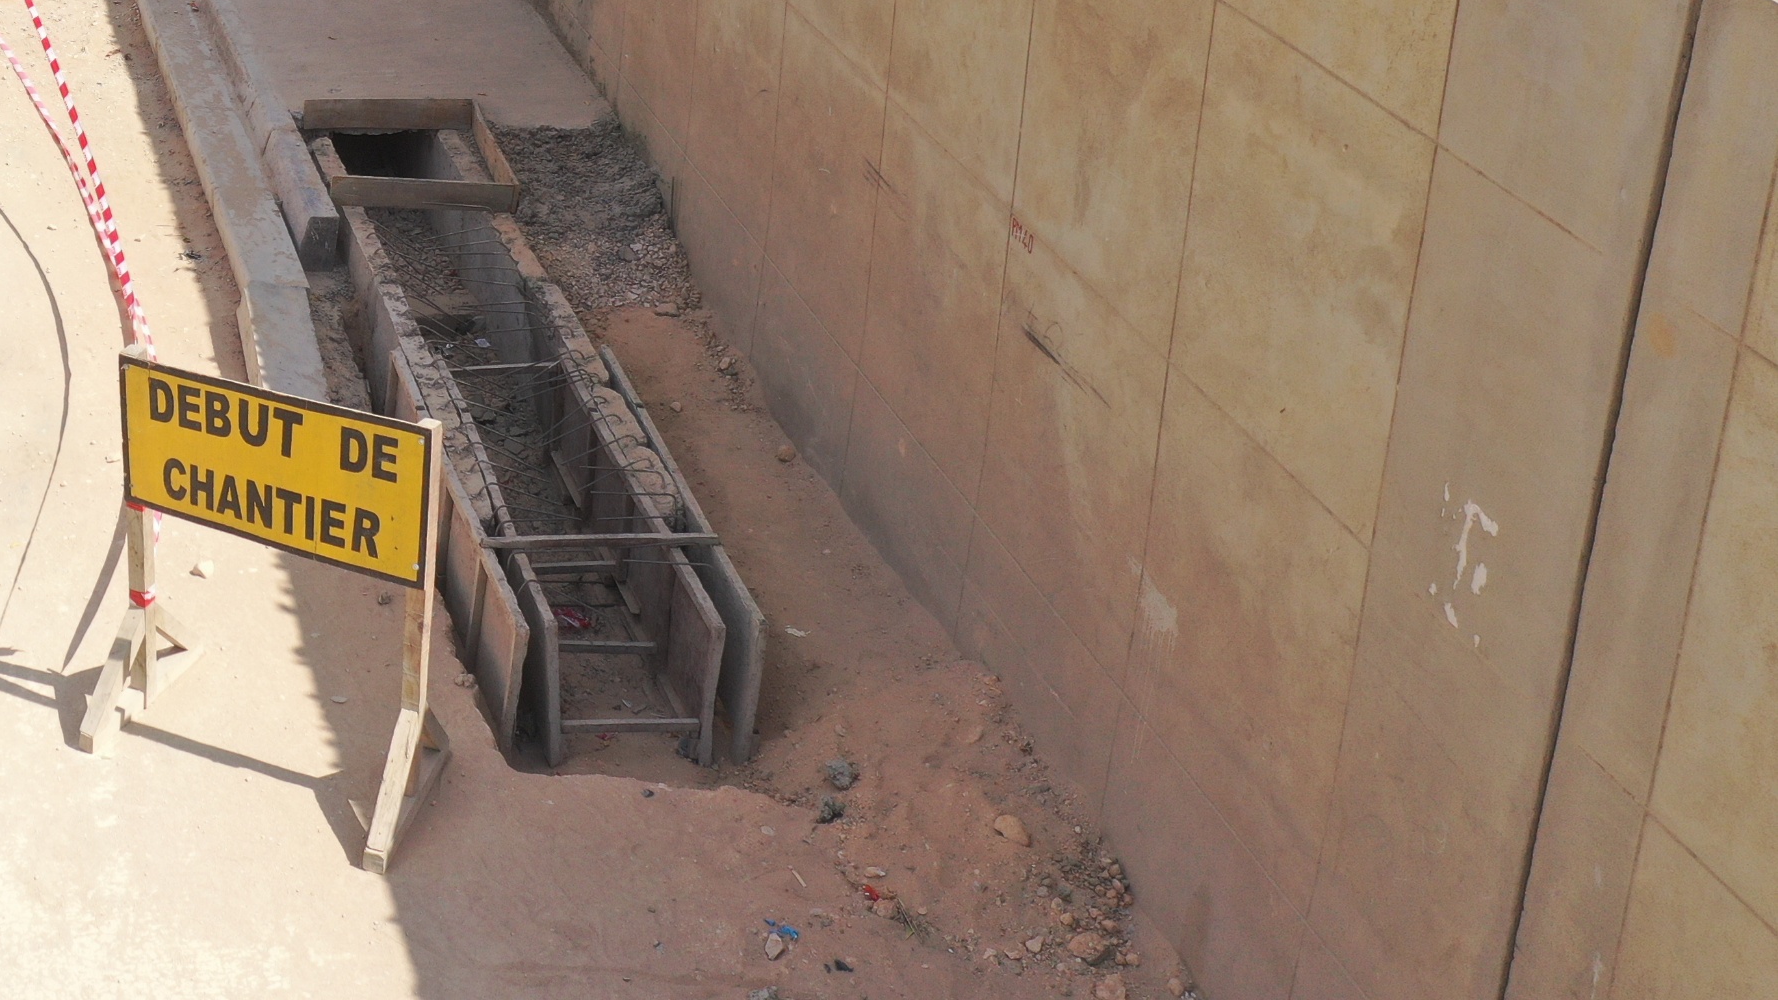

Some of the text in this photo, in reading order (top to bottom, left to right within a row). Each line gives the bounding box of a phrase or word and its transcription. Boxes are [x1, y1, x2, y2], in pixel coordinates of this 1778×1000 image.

[148, 376, 400, 484] DEBUT DE
[162, 457, 381, 560] CHANTIER
